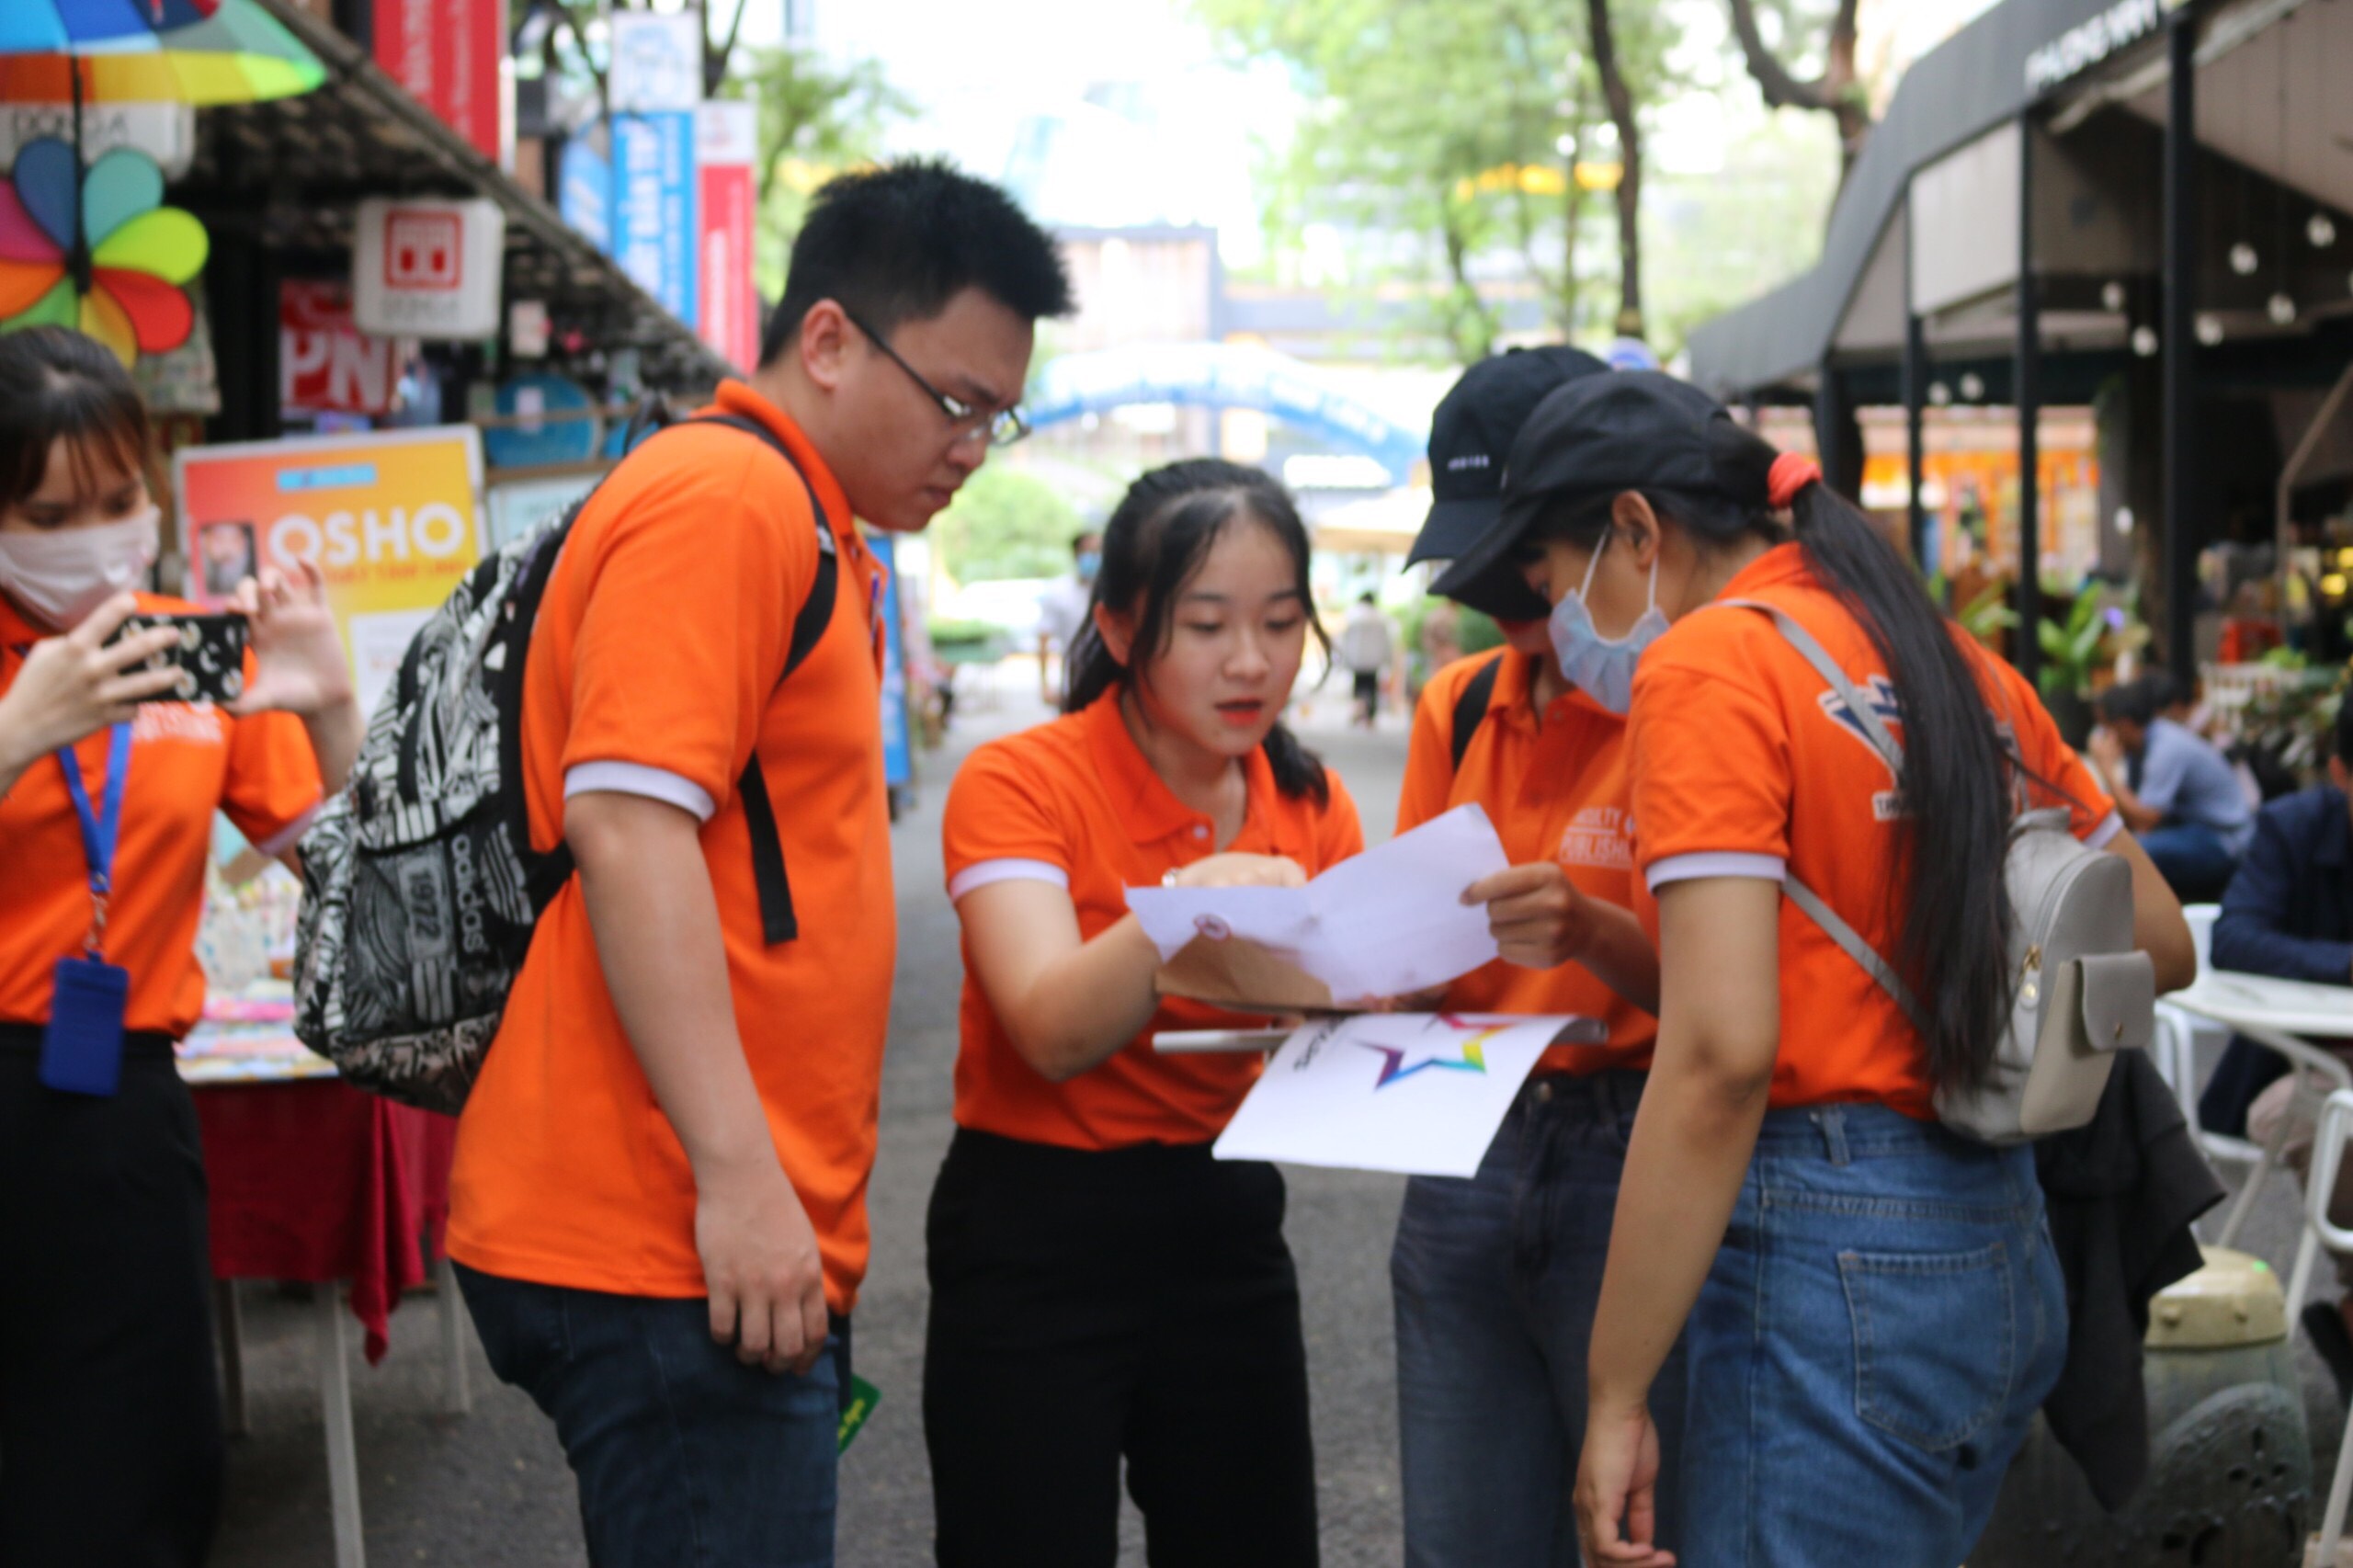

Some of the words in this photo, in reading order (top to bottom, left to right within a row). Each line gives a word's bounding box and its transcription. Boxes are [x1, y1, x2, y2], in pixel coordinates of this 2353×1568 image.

[268, 502, 465, 570] OSHO
[411, 869, 442, 939] 1972
[451, 834, 486, 953] adidas
